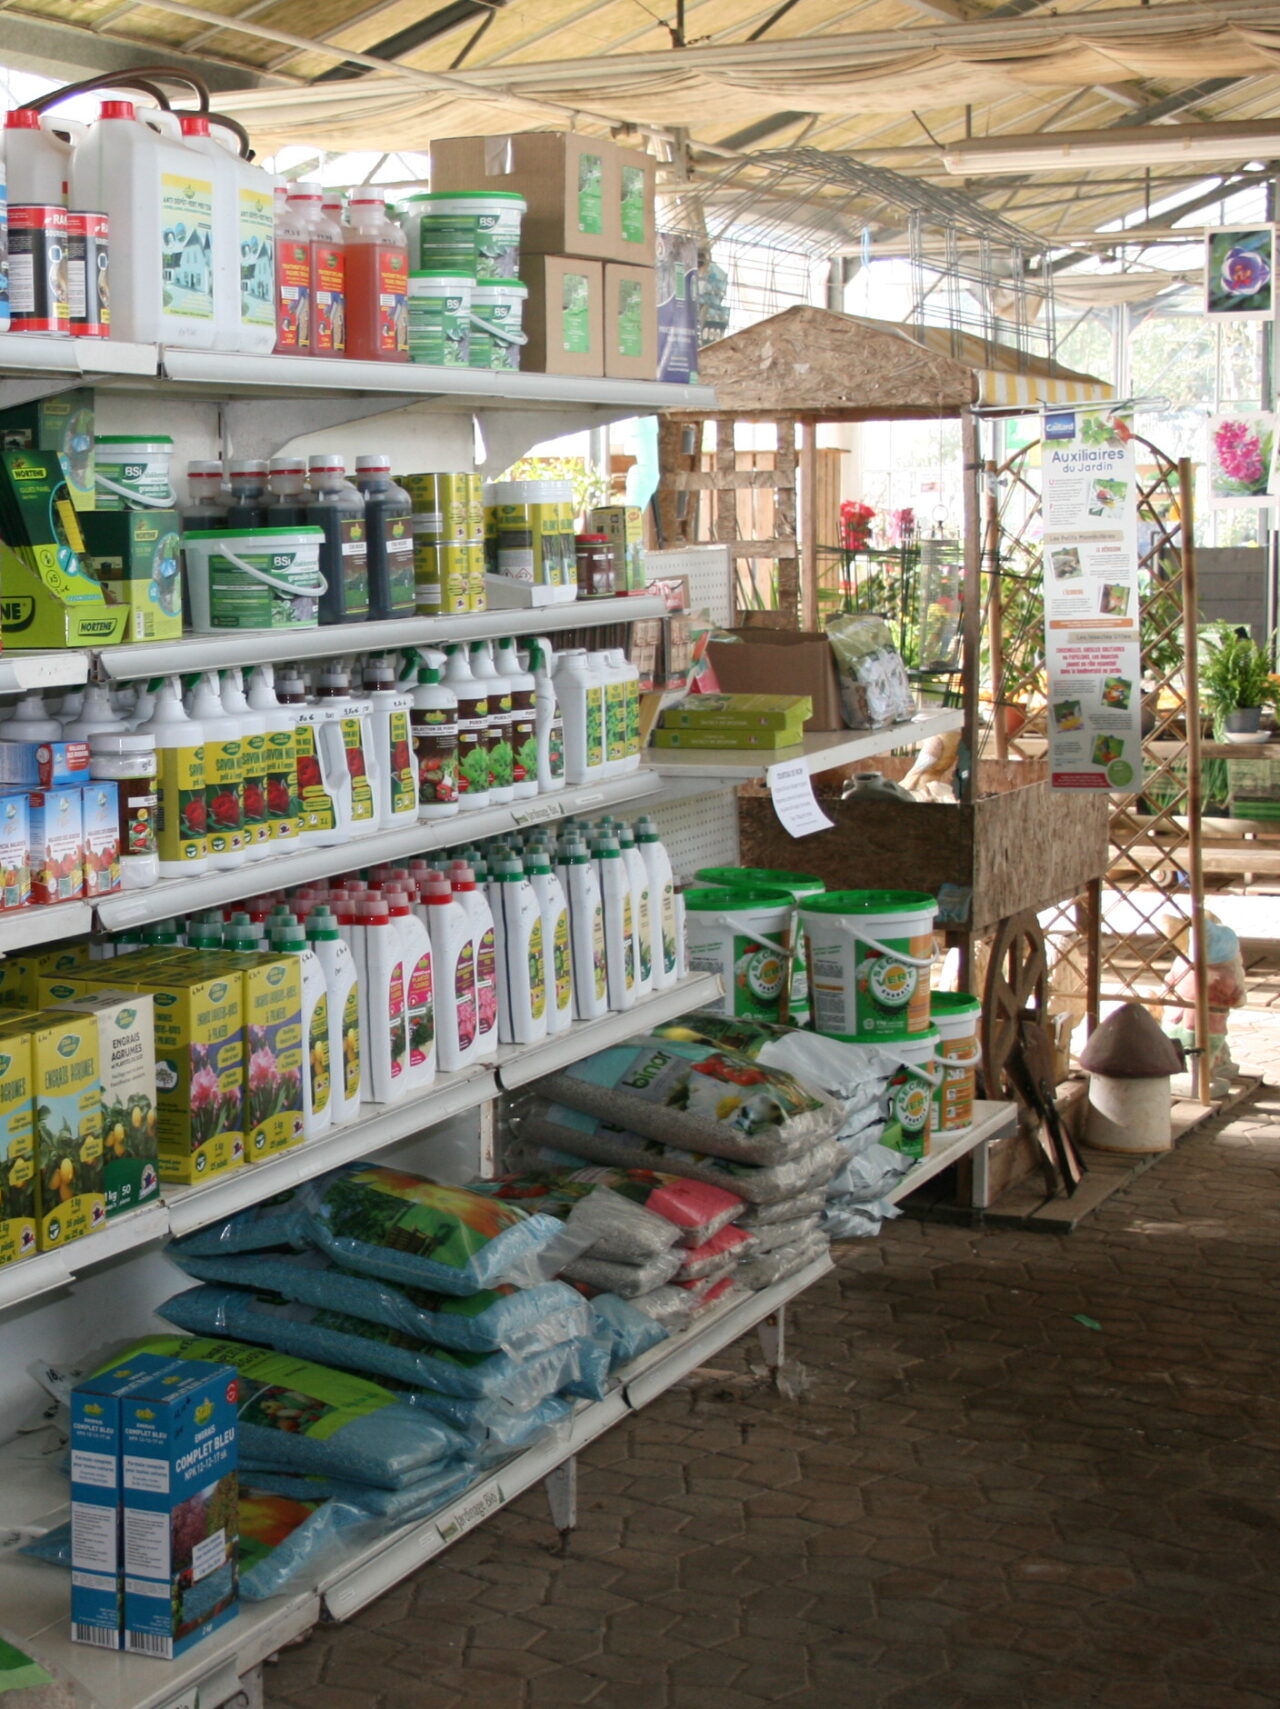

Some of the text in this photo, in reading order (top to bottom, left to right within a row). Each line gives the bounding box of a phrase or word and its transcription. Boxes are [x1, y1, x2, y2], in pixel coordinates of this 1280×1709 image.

[1051, 448, 1124, 463] Auxiliaires
[15, 469, 45, 478] NORTENE
[125, 464, 143, 477] BSi
[1063, 462, 1113, 473] du Jardin
[274, 555, 291, 567] BSi
[80, 621, 113, 632] NORTENE
[875, 968, 913, 987] VERT
[112, 1032, 140, 1049] ENGRAIS
[111, 1043, 142, 1061] AGRUMES
[121, 1184, 131, 1196] 50
[73, 1423, 114, 1435] COMPLET BLEU
[124, 1427, 167, 1439] COMPLET BLEU
[194, 1424, 216, 1444] ENGRAIS
[175, 1426, 235, 1473] COMPLET BLEU
[184, 1466, 197, 1481] NPK
